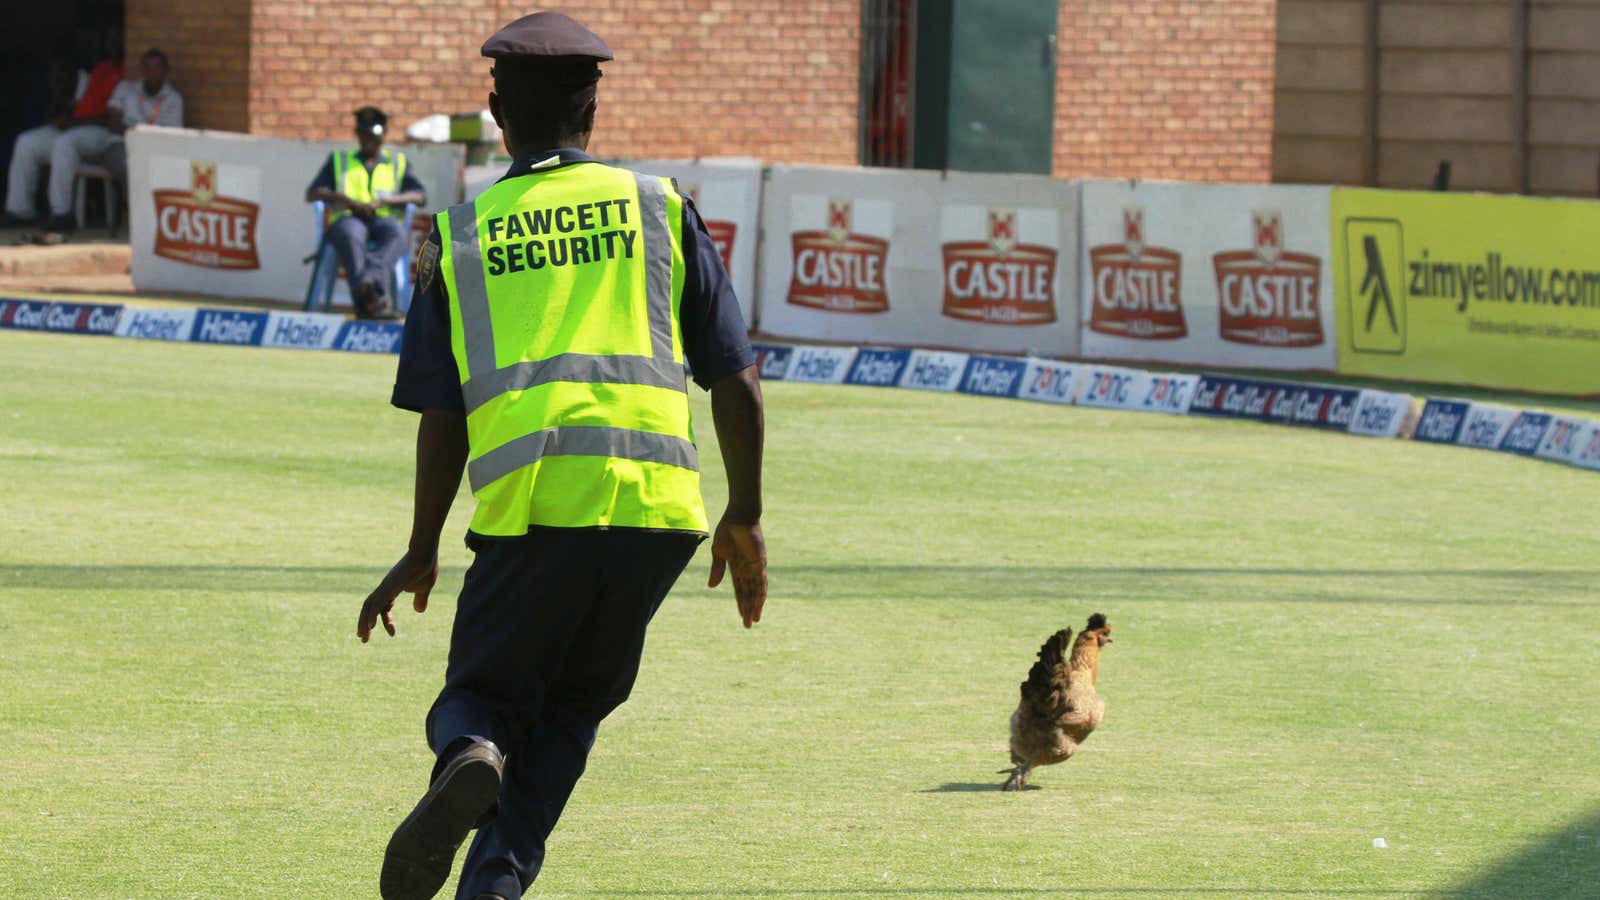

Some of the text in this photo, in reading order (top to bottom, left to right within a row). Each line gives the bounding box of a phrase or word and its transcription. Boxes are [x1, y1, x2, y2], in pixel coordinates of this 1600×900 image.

[160, 206, 250, 250] CASTLE
[487, 199, 631, 242] FAWCETT
[487, 230, 637, 277] SECURITY
[796, 249, 880, 291] CASTLE
[949, 260, 1049, 302] CASTLE
[1098, 266, 1178, 312] CASTLE
[1222, 273, 1316, 319] CASTLE
[1409, 249, 1600, 313] zimyellow.com
[126, 311, 184, 339] Haier
[202, 312, 257, 342] Haier
[273, 315, 329, 346] Haier
[343, 323, 399, 352] Haier
[852, 351, 903, 384] Haier
[908, 354, 957, 388] Haier
[967, 359, 1018, 395] Haier
